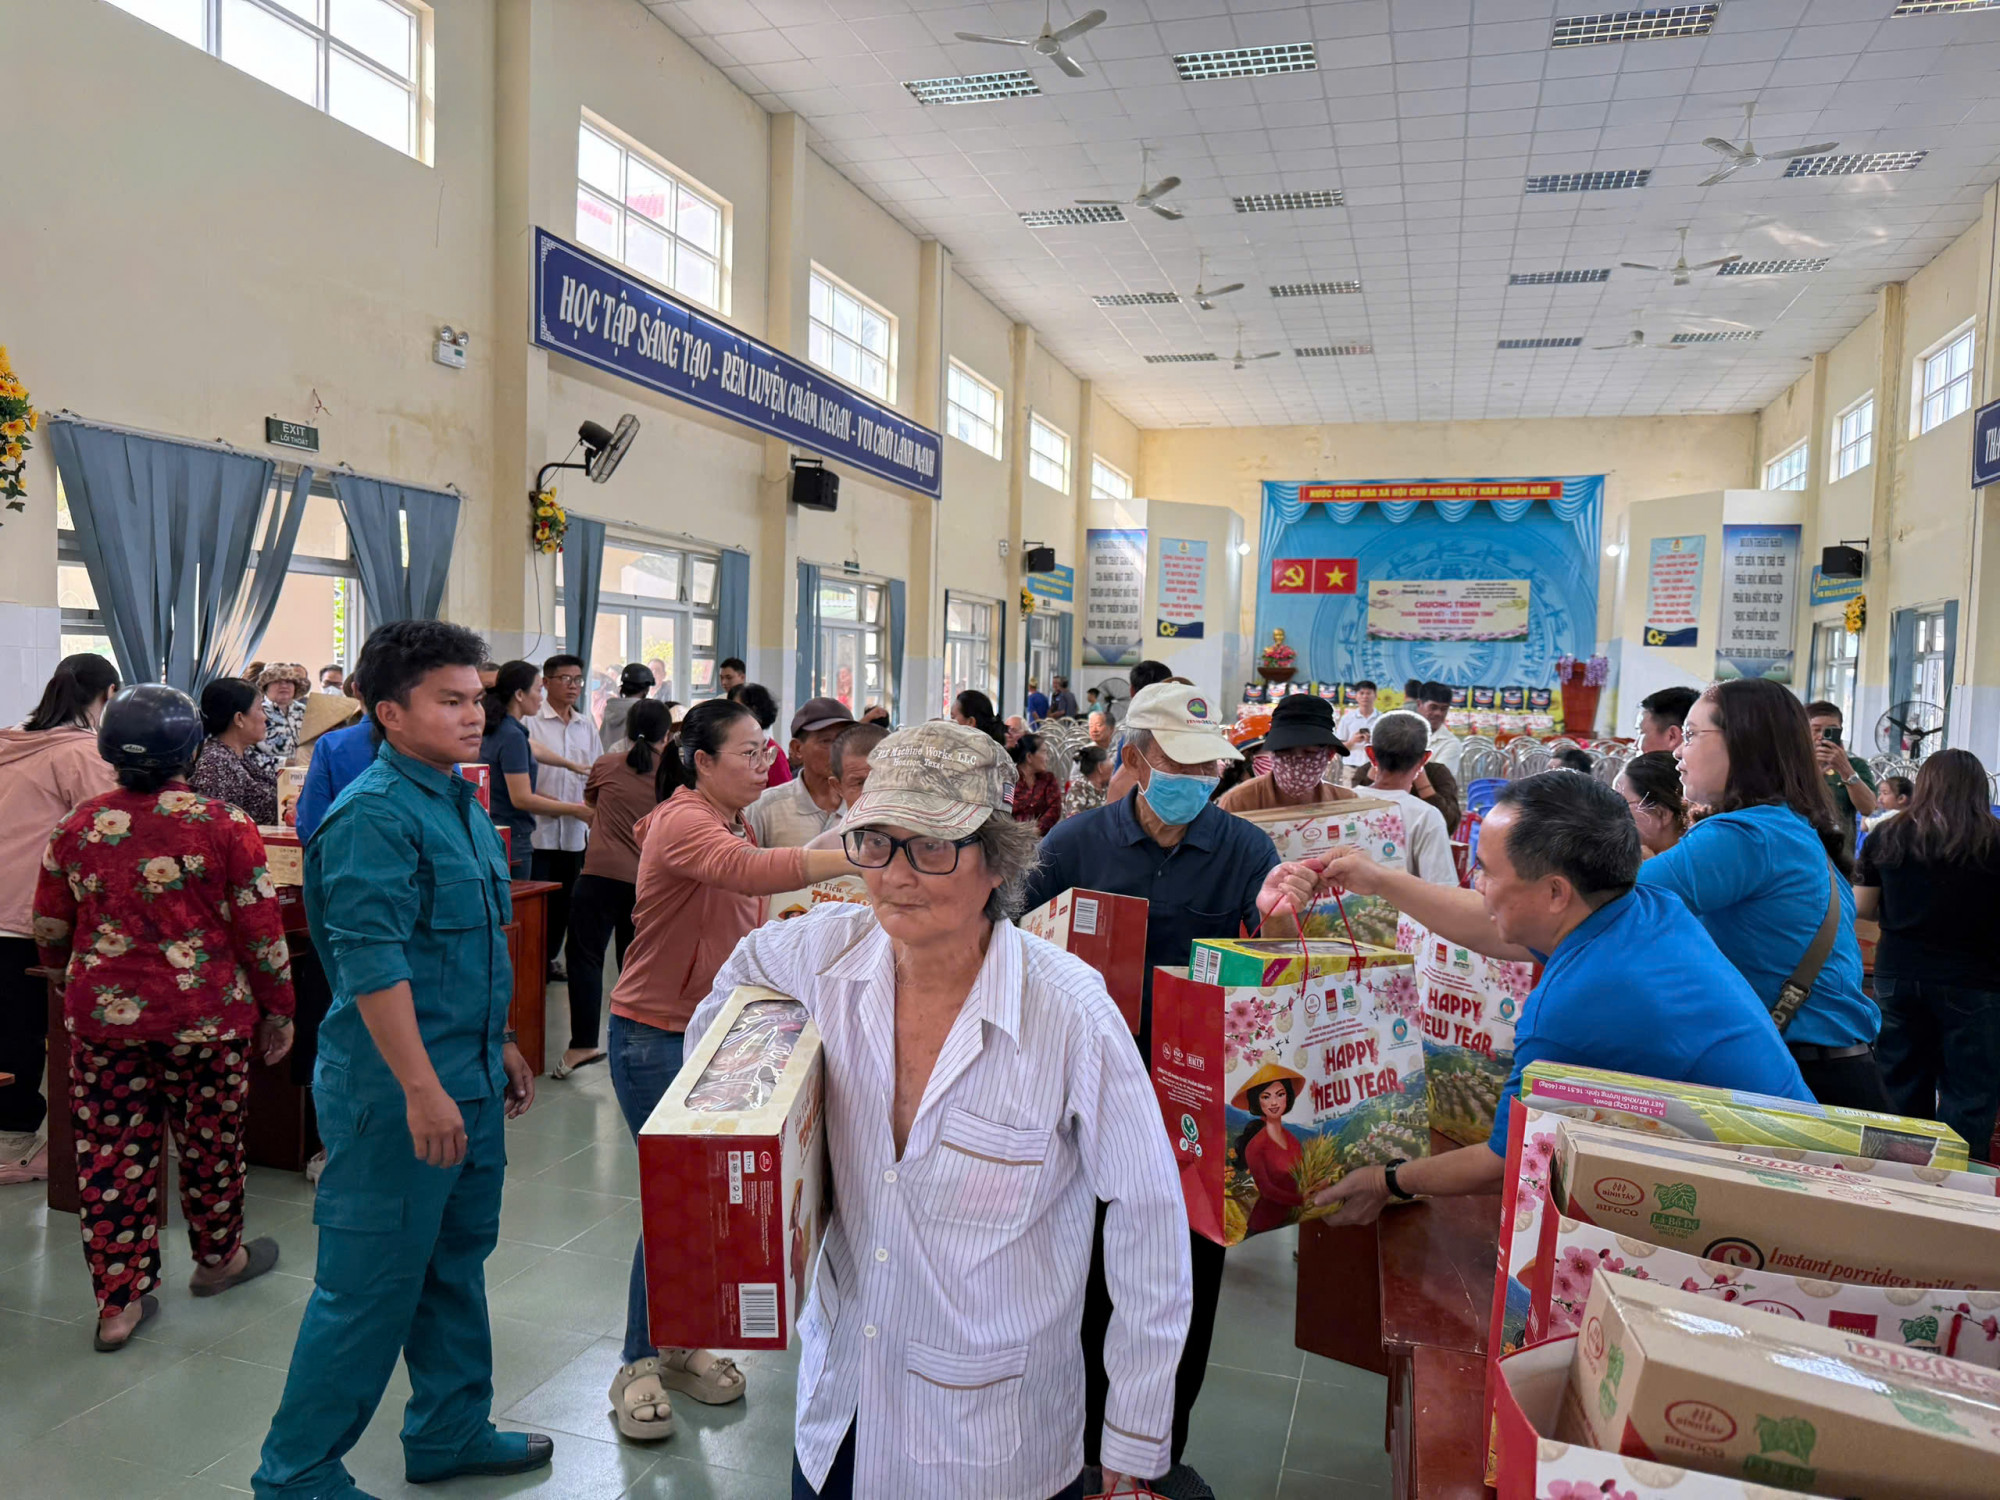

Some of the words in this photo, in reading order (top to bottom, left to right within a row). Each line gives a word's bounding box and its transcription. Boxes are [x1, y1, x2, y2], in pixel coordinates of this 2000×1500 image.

[560, 275, 600, 340] HỌC
[603, 290, 637, 356] TẬP
[637, 306, 680, 369] SÁNG
[683, 331, 711, 388] TẠO
[720, 344, 749, 397] RÈN
[749, 364, 788, 420] LUYỆN
[787, 381, 818, 428] CHĂM
[818, 396, 852, 443] NGOAN
[857, 415, 873, 451] VUI
[873, 424, 893, 460] CHƠI
[893, 428, 914, 470] LÀNH
[913, 443, 936, 481] MẠNH
[282, 423, 306, 436] EXIT
[281, 433, 290, 441] LỐI
[924, 758, 944, 769] Texas
[958, 752, 977, 765] LLC
[1428, 987, 1483, 1022] HAPPY
[1453, 1022, 1494, 1056] YEAR
[1325, 1038, 1377, 1073] HAPPY
[1313, 1078, 1351, 1113] NEW
[1353, 1067, 1400, 1100] YEAR
[1568, 1086, 1583, 1094] 16.51
[1593, 1098, 1613, 1107] Bowls
[1650, 1100, 1665, 1108] NET
[1602, 1189, 1620, 1198] BÌNH
[1596, 1203, 1639, 1217] BIFOCO
[1769, 1247, 1831, 1274] Instant
[1830, 1262, 1911, 1289] porridge
